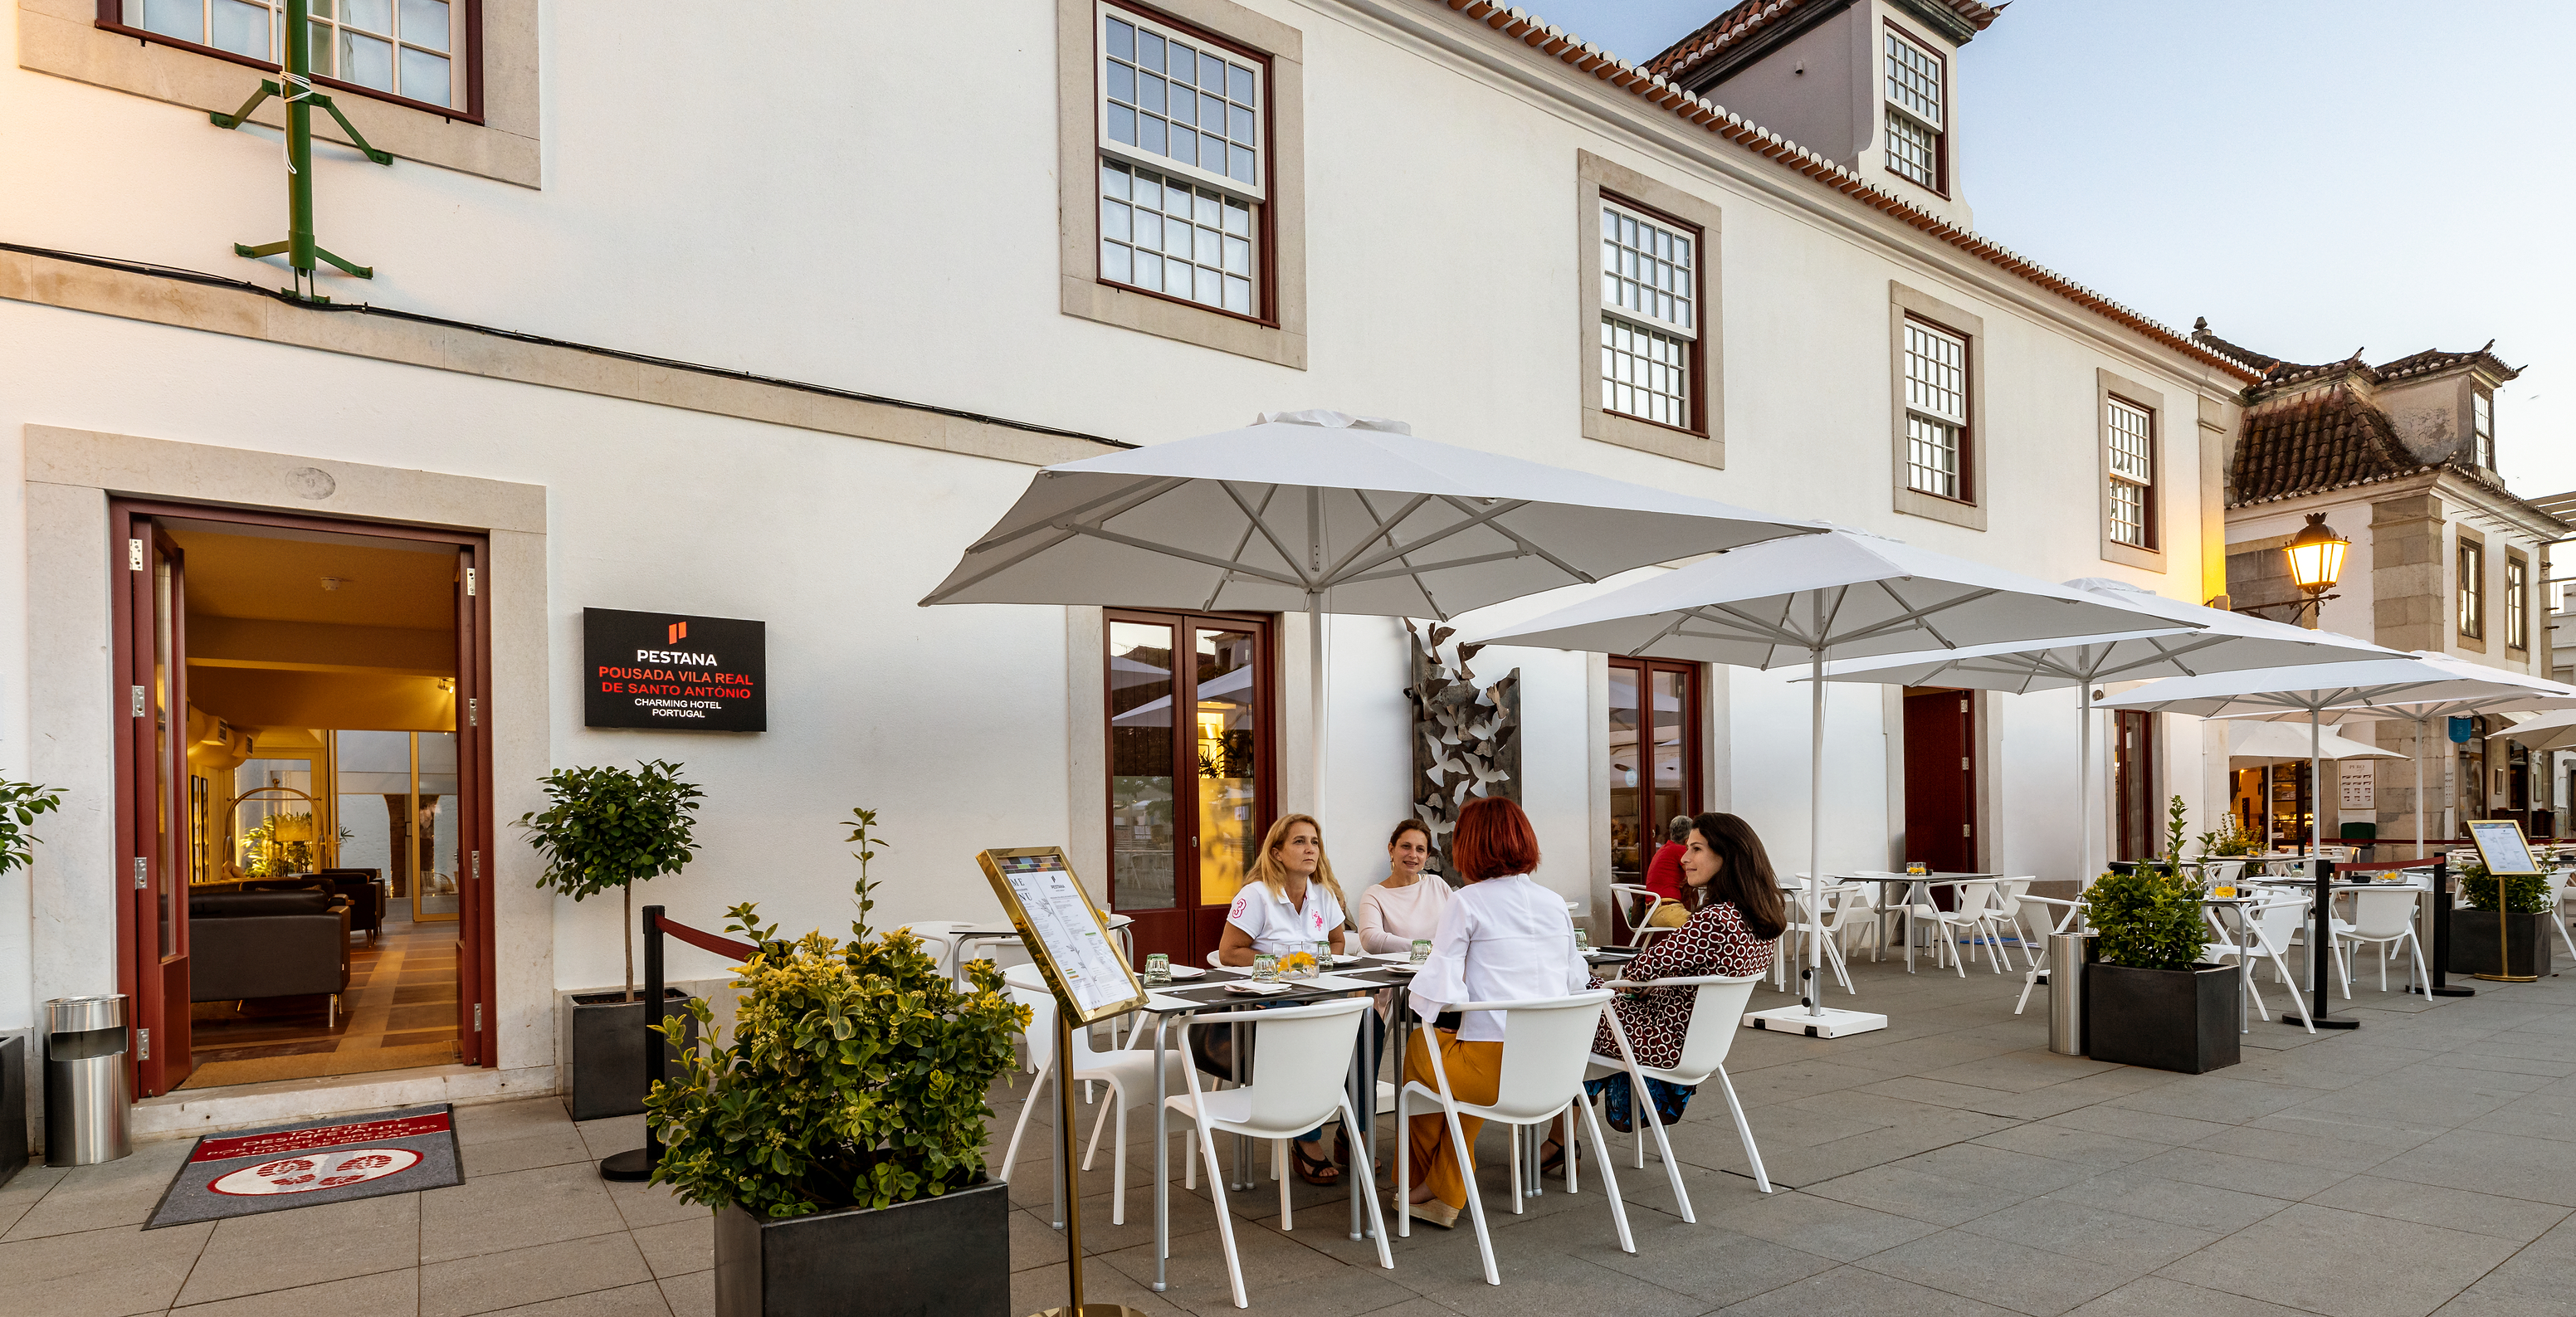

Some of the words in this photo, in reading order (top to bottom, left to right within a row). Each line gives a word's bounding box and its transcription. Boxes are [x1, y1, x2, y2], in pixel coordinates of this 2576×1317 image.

[637, 649, 718, 666] PESTANA
[598, 666, 676, 681] POUSADA
[678, 671, 712, 683] VILA
[715, 673, 754, 685] REAL
[602, 681, 623, 693] DE
[628, 683, 681, 695] SANTO
[684, 685, 751, 699] ANTÓNIO
[634, 698, 688, 708] CHARMING
[690, 700, 722, 710] HOTEL
[652, 709, 705, 718] PORTUGAL
[1010, 877, 1025, 886] ME
[1018, 892, 1032, 902] NU
[1232, 898, 1247, 919] 3
[242, 1123, 410, 1146] DESINFETANTE
[290, 1123, 368, 1135] TAPETE
[236, 1144, 300, 1155] ANTES
[340, 1131, 409, 1143] ENTRAR
[323, 1132, 372, 1141] LIMPE
